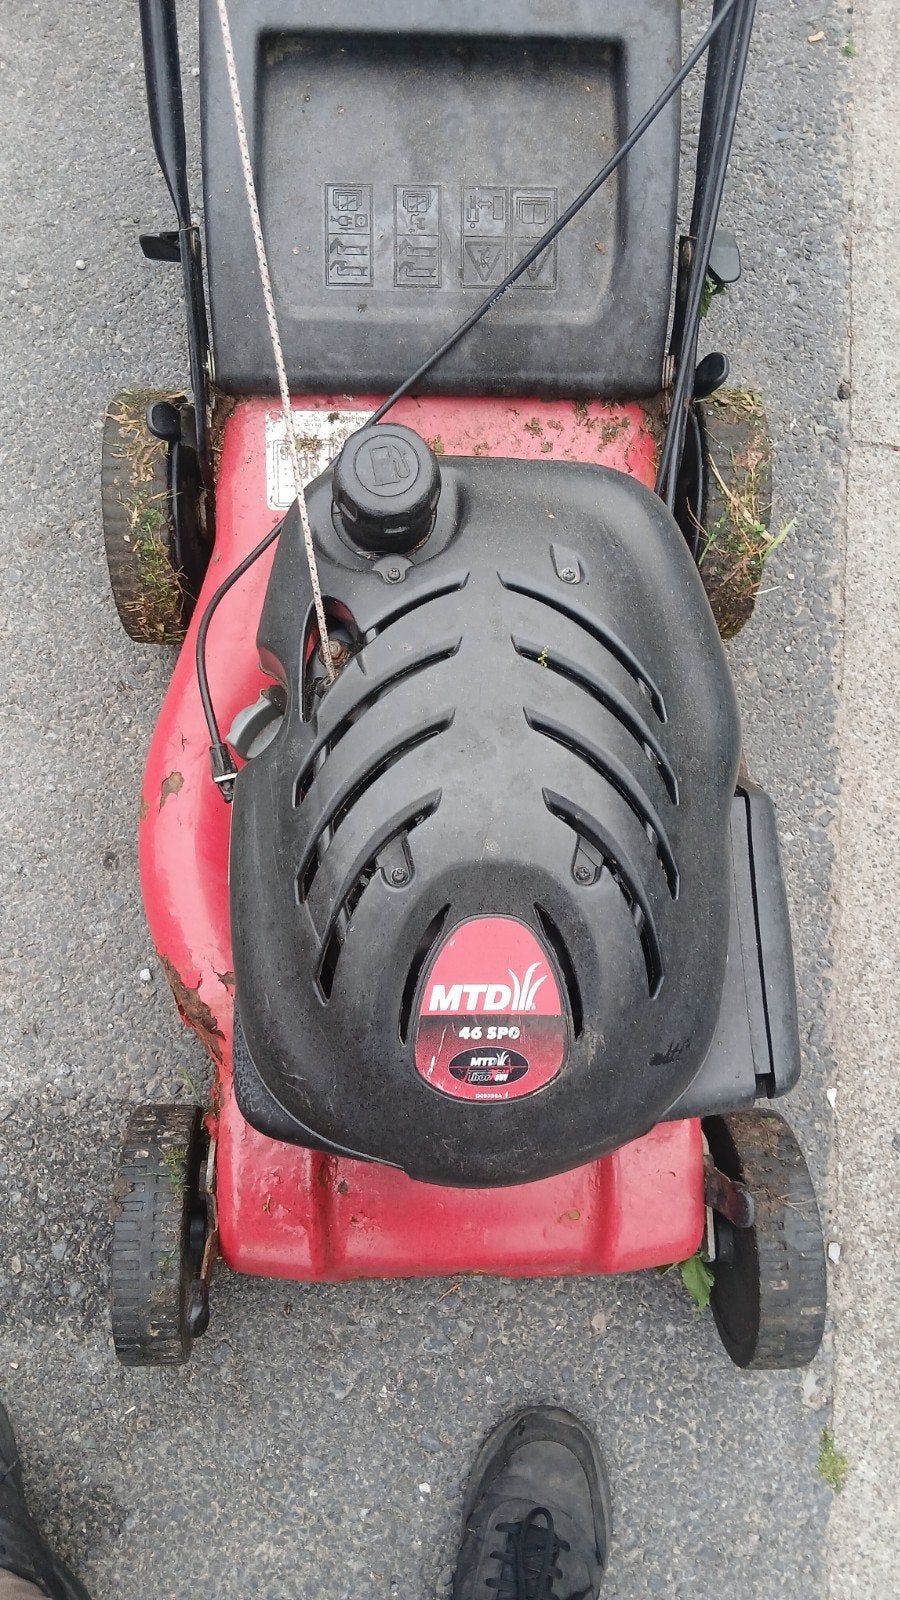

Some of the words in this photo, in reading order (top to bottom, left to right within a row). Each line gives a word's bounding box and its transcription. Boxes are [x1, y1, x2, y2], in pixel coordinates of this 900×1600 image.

[429, 984, 512, 1011] MTD
[458, 1026, 483, 1040] 46
[470, 1057, 498, 1067] MTD
